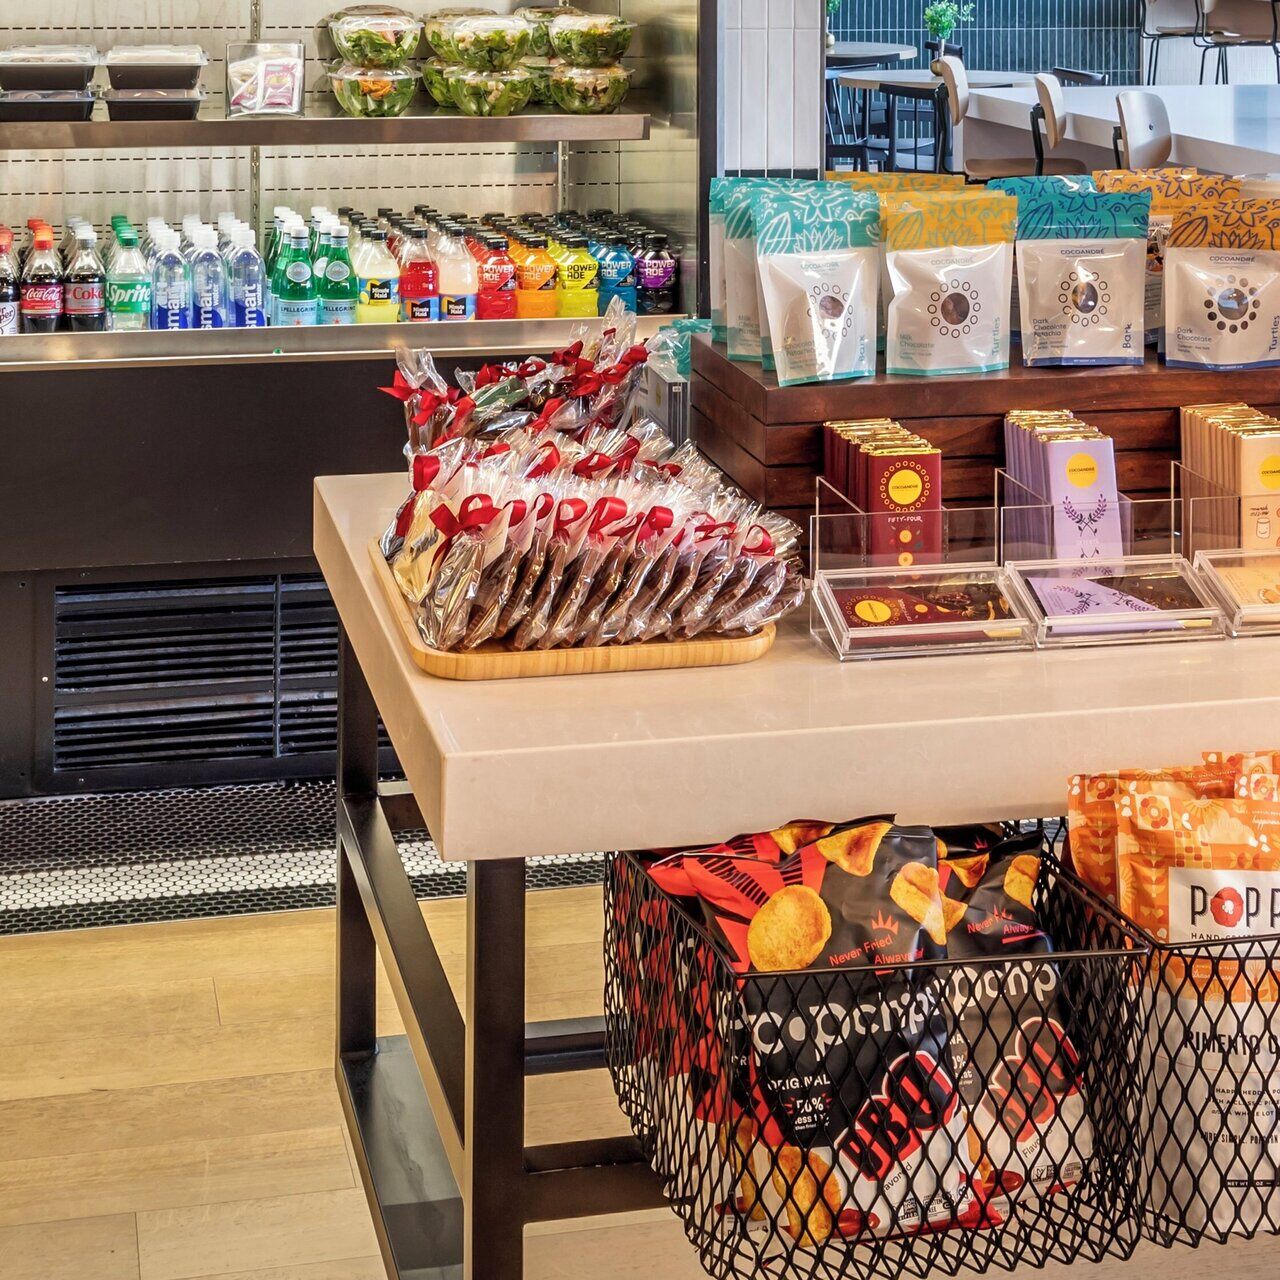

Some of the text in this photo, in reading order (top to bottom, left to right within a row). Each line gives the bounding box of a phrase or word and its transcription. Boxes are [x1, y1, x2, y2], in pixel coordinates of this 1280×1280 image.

[1060, 247, 1105, 255] COCOANDRÉ
[1209, 255, 1256, 263] COCOANDRÉ
[483, 264, 515, 273] POWER
[524, 264, 555, 273] POWER
[567, 263, 598, 272] POWER
[601, 261, 632, 270] POWER
[645, 259, 676, 269] POWER
[26, 287, 61, 301] Coca-Cola
[72, 286, 103, 301] Coke
[108, 283, 150, 305] Sprite
[245, 283, 257, 330] smart
[1032, 317, 1049, 325] Dark
[1033, 323, 1067, 332] Chocolate
[991, 316, 1001, 356] Turtles
[1122, 322, 1133, 349] Bark
[1269, 314, 1280, 352] Turtles
[1177, 334, 1213, 343] Chocolate
[887, 515, 923, 524] FIFTY-FOUR
[967, 918, 993, 934] Never
[829, 934, 894, 967] Never Fried
